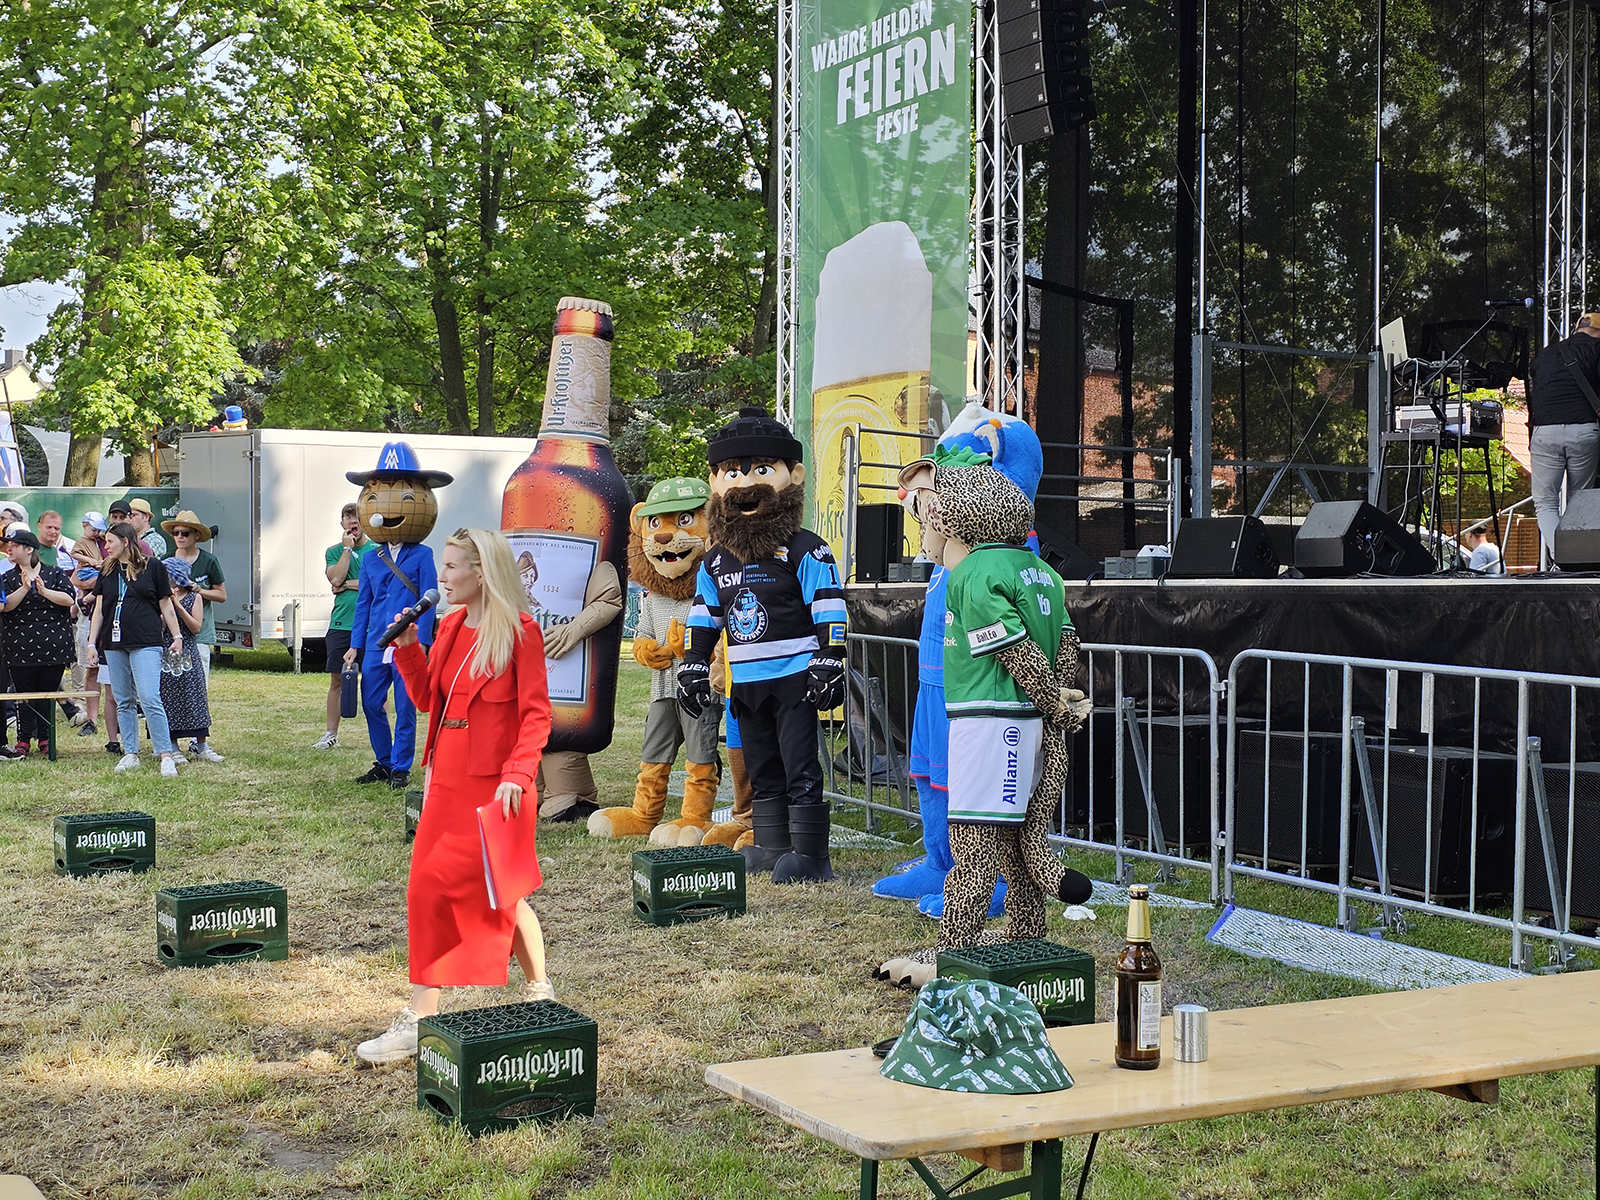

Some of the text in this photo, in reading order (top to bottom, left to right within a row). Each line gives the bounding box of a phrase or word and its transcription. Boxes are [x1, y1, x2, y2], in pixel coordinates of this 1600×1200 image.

[811, 0, 933, 72] WAHRE HELDEN
[837, 22, 955, 125] FEIERN
[876, 102, 919, 144] FESTE
[543, 585, 559, 593] 1534
[717, 571, 743, 588] KSW
[677, 663, 709, 674] AUER
[808, 657, 843, 668] AUER
[1002, 749, 1018, 805] Allianz
